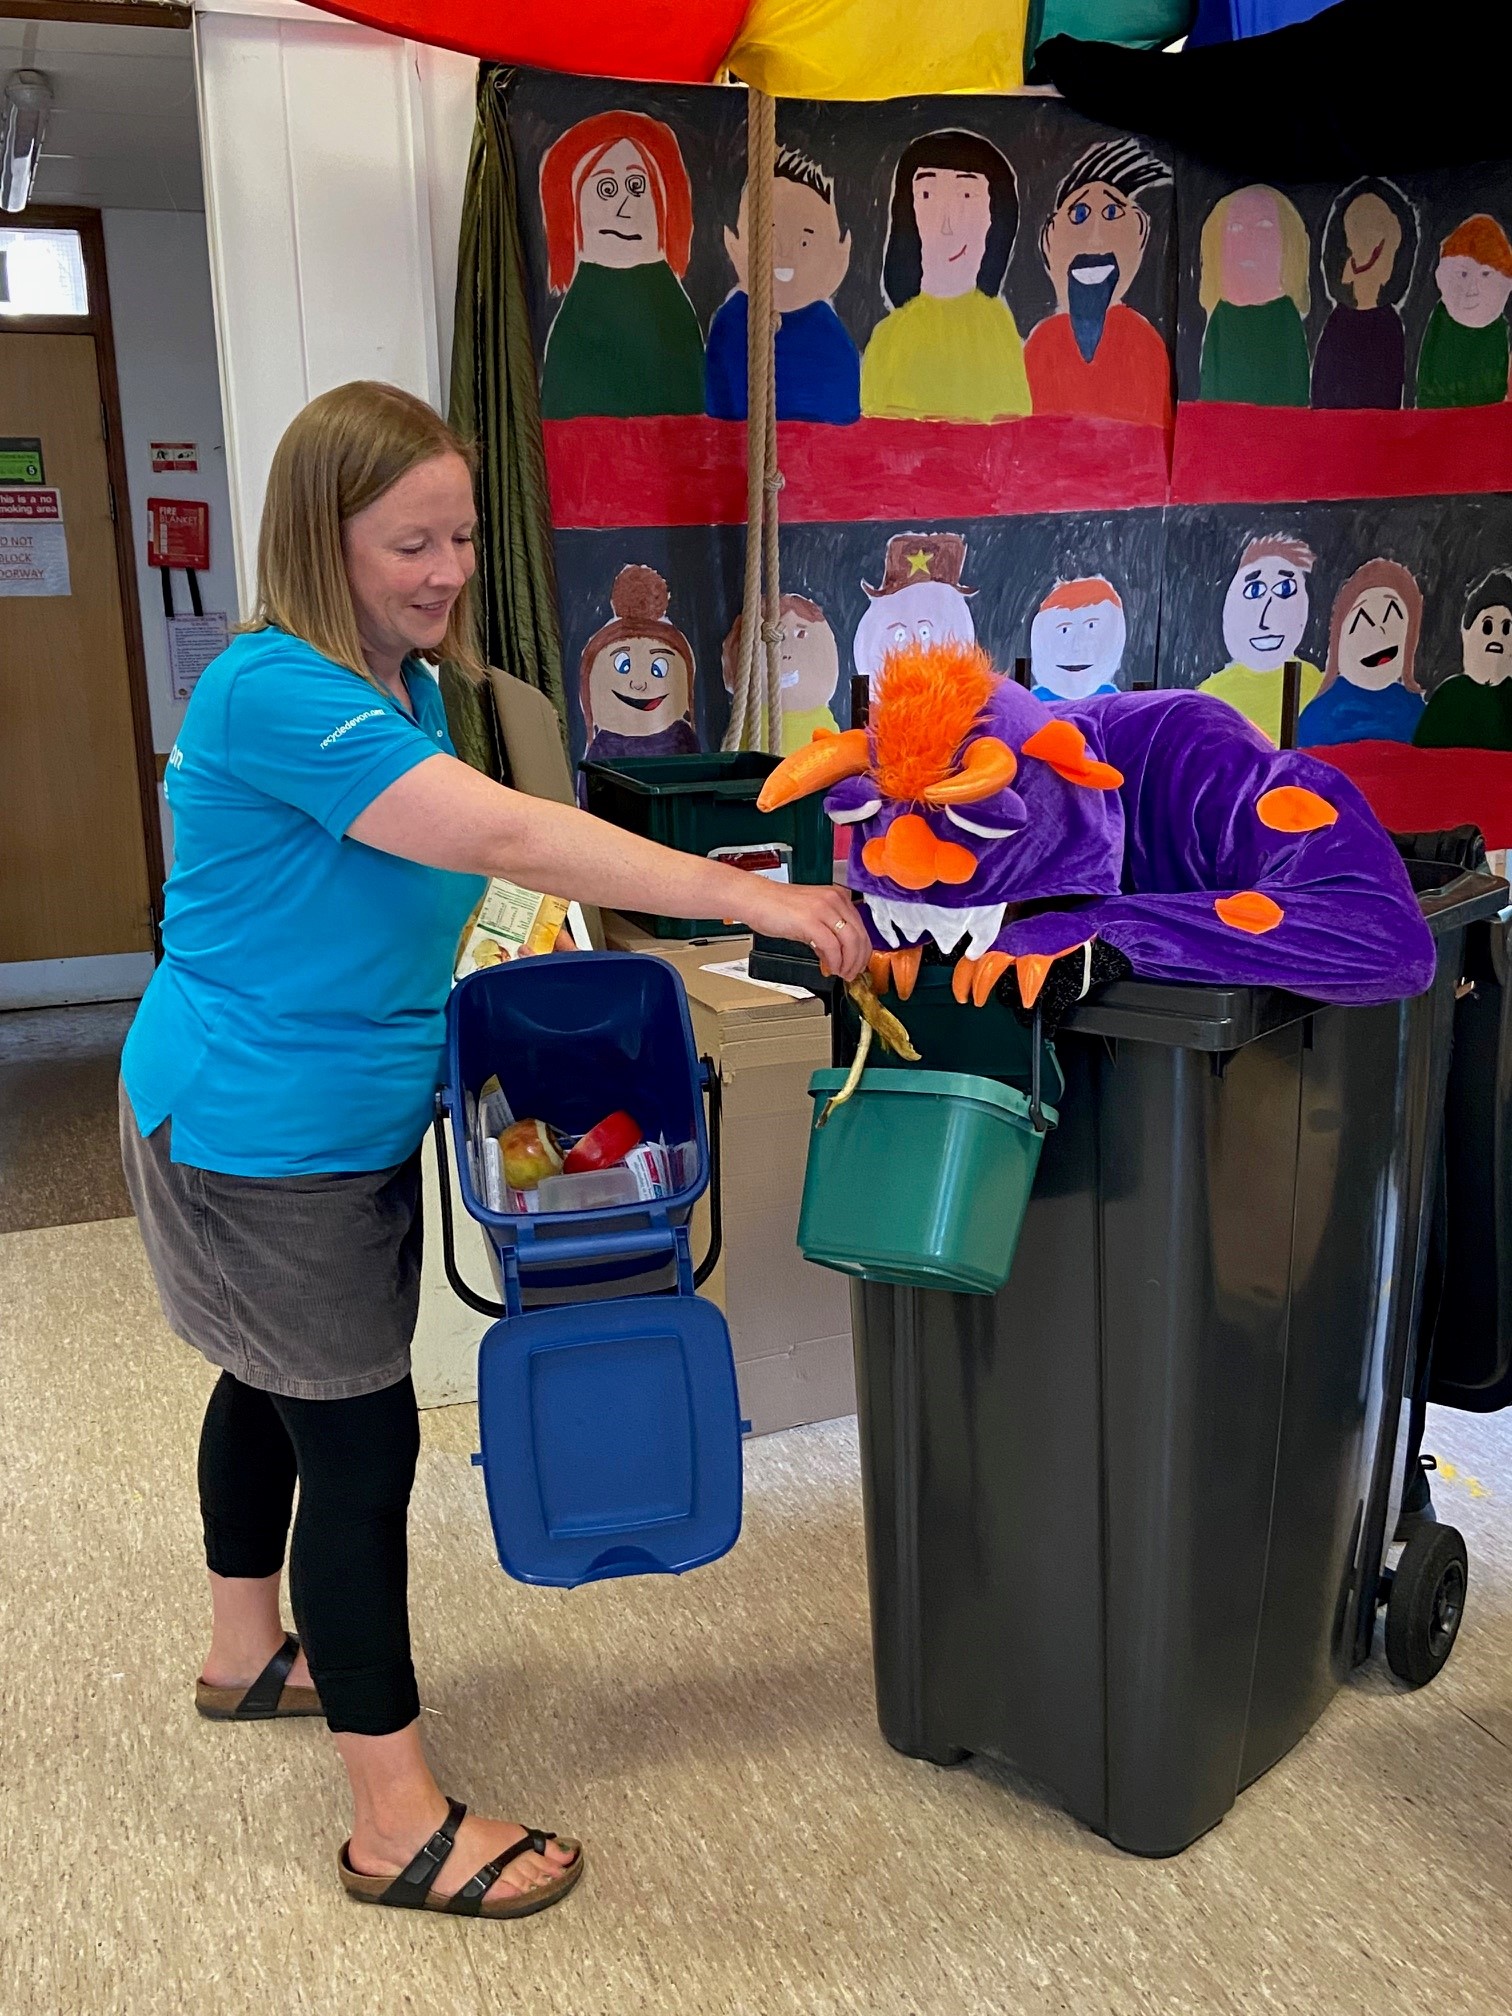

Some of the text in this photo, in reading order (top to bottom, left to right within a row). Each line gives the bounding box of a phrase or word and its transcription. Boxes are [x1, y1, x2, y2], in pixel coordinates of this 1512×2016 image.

[29, 466, 35, 475] 5
[0, 494, 15, 503] his
[17, 494, 27, 503] is
[0, 504, 57, 515] moking area
[159, 506, 177, 516] FIRE
[159, 514, 198, 525] BLANKET
[11, 536, 33, 546] NOT
